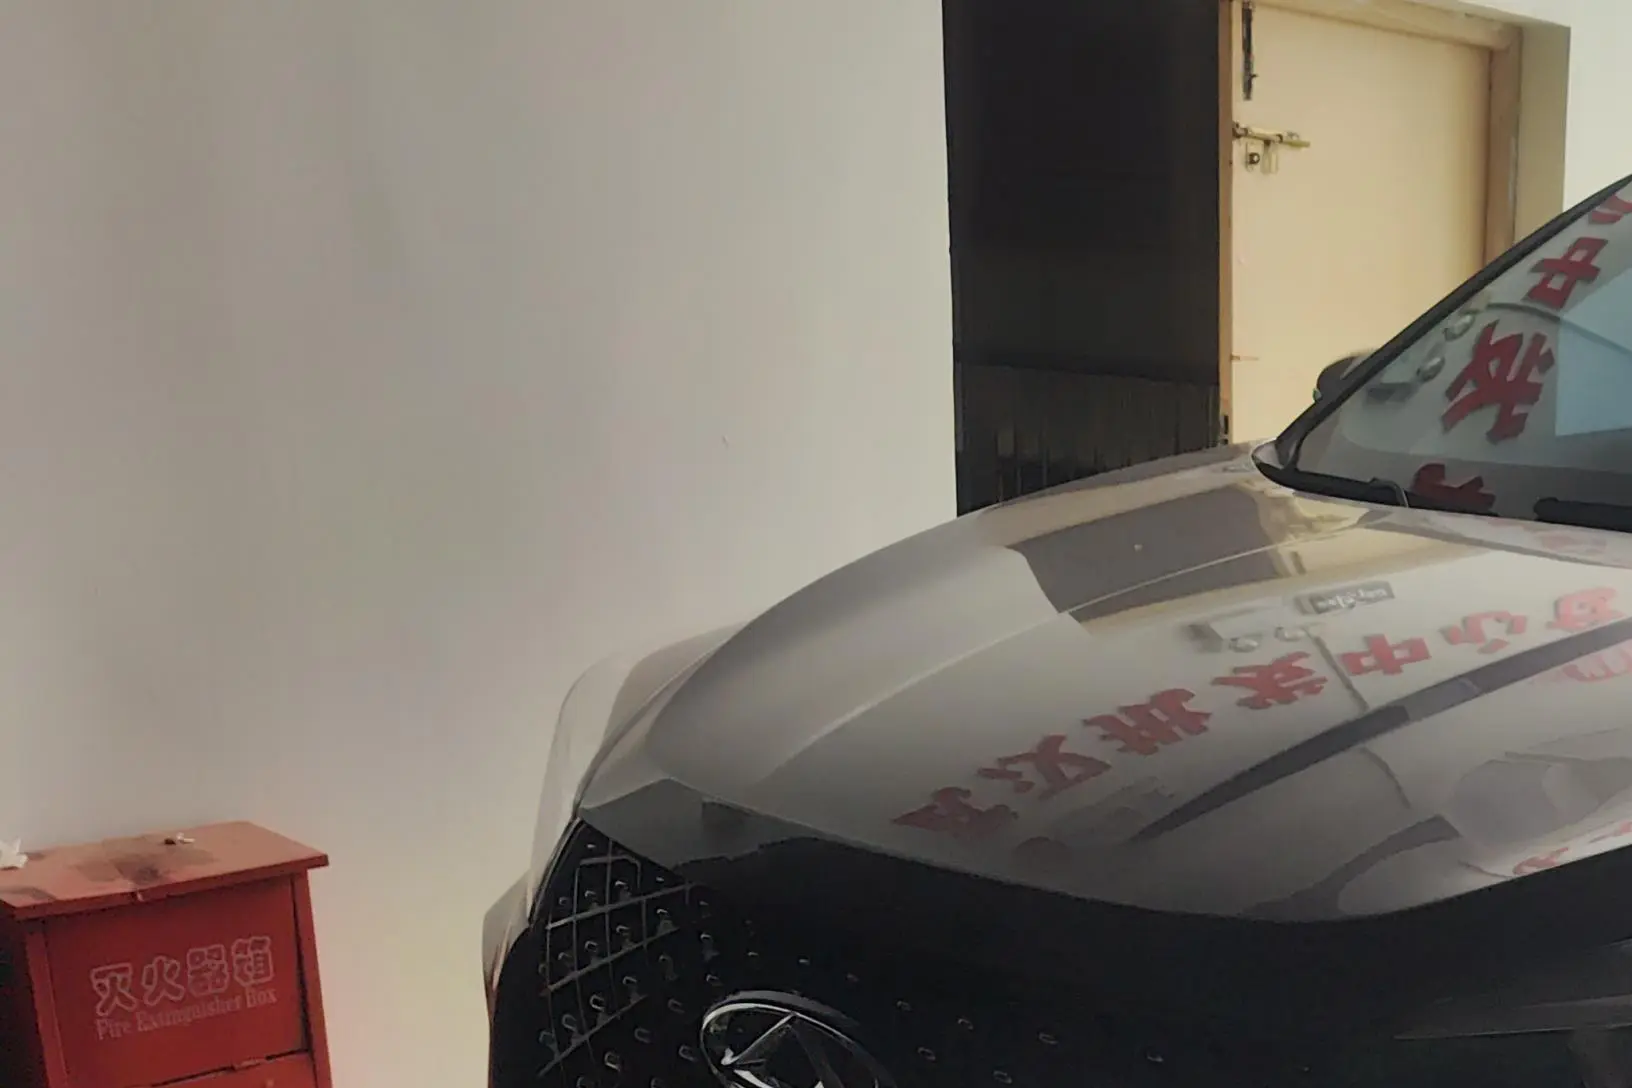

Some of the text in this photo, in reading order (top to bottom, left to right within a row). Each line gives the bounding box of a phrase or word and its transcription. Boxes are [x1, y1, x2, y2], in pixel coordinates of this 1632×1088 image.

[90, 936, 275, 1016] 灭火器箱
[95, 987, 278, 1040] Fire Extinguisher Box
